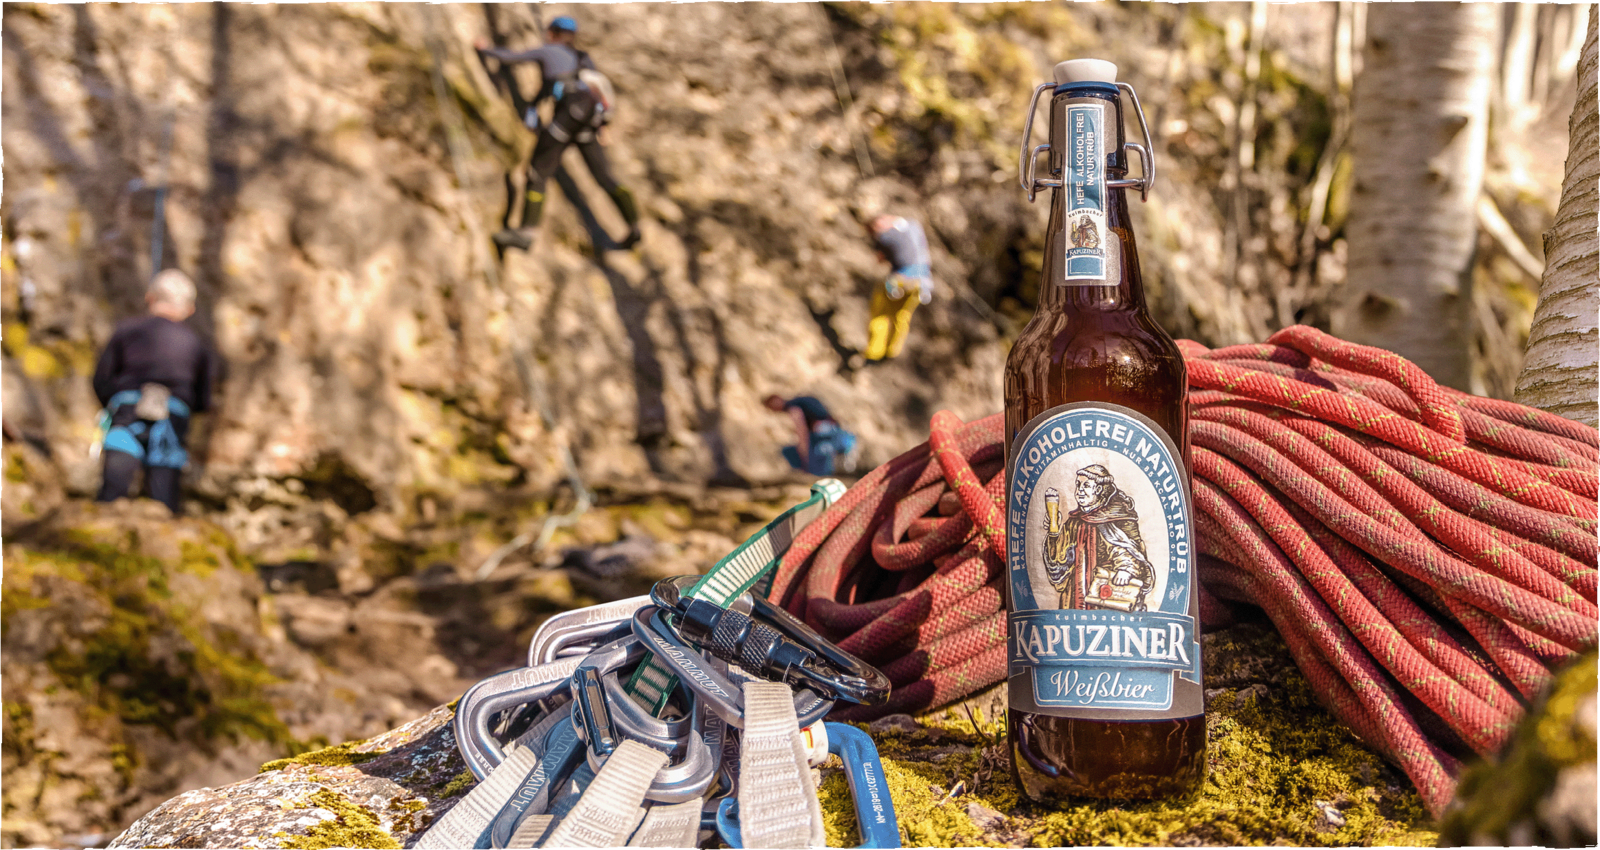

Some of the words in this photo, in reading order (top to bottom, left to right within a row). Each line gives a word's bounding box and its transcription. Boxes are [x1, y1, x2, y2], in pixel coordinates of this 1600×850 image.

[1076, 113, 1085, 177] ALKOHOLFREI
[1085, 131, 1095, 186] NATURTRÜB
[1076, 180, 1085, 205] HEFE
[1014, 419, 1134, 507] ALKOHOLFREI
[1020, 487, 1032, 570] KALORIENARM
[1034, 438, 1109, 475] VITAMINHALTIG
[1122, 447, 1142, 465] NUR
[1154, 480, 1169, 510] KCAL
[1166, 514, 1175, 538] PRO
[1135, 436, 1188, 574] NATURTRÜB
[1011, 508, 1021, 571] HEFE
[1013, 620, 1191, 666] KAPUZINER
[1055, 613, 1143, 623] Kulmbacher
[653, 637, 730, 699] MAMMUT
[1050, 670, 1155, 705] Weißbier
